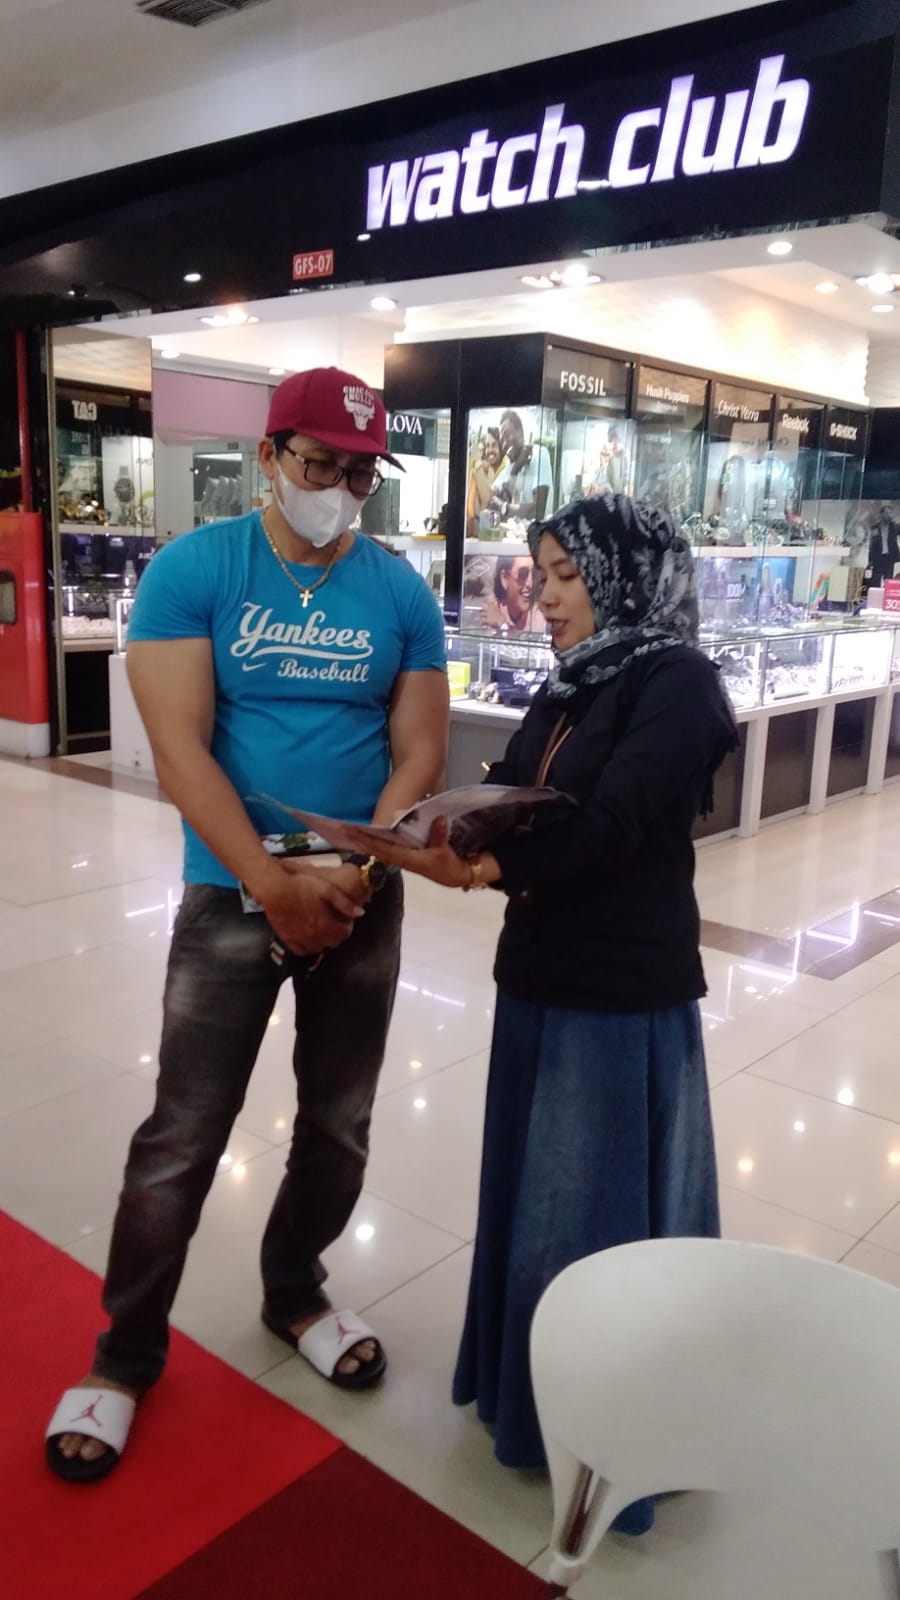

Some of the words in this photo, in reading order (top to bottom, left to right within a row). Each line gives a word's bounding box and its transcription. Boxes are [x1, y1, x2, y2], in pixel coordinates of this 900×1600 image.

[366, 103, 584, 230] watch
[608, 54, 810, 189] club
[293, 254, 332, 277] GFS-07
[560, 371, 606, 397] FOSSIL
[718, 400, 740, 418] Christ
[782, 413, 810, 433] Reebok
[231, 601, 374, 660] Yankees
[278, 658, 370, 682] Baseball
